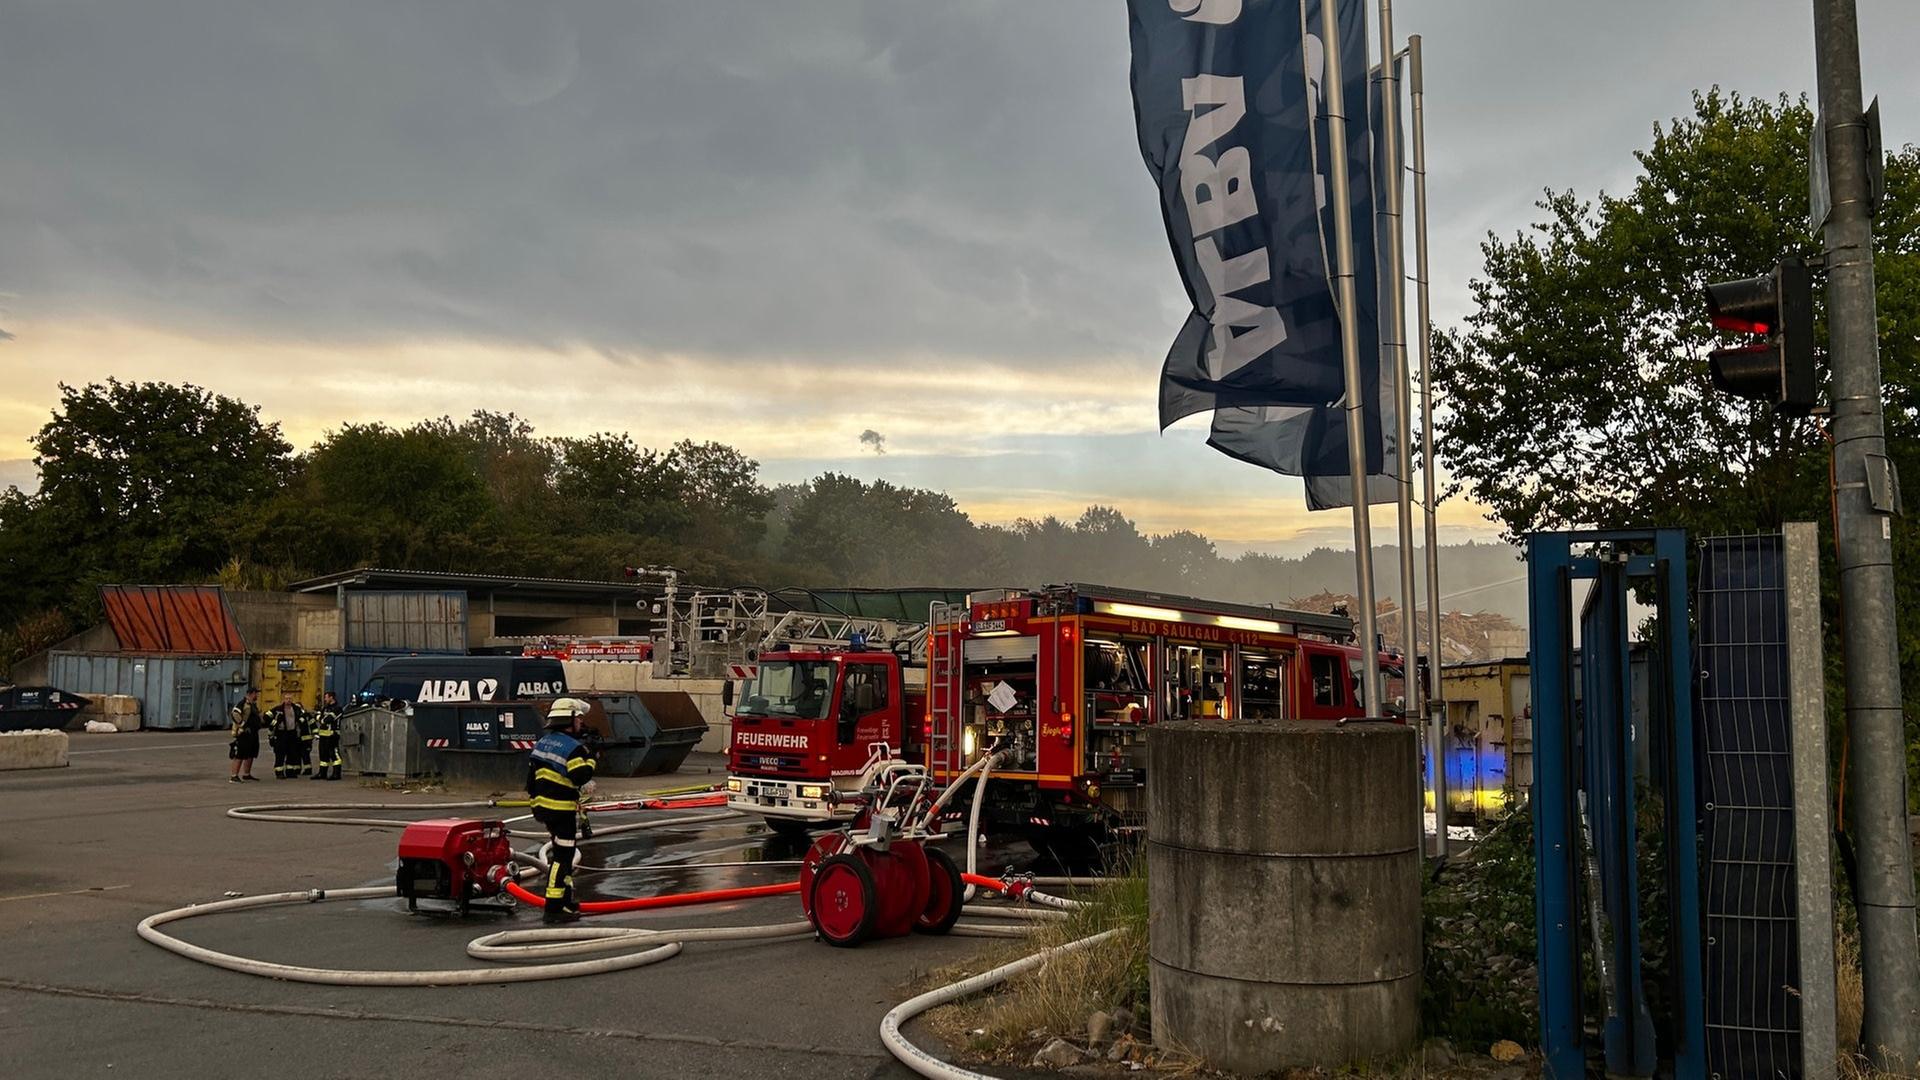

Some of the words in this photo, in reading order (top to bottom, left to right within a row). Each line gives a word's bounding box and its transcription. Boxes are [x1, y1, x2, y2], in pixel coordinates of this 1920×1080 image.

[1131, 621, 1157, 634] BAD
[1162, 624, 1220, 641] SAULGAU
[1239, 633, 1259, 645] 112
[417, 680, 472, 702] ALBA
[517, 682, 550, 695] ALBA
[736, 732, 808, 749] FEUERWEHR
[759, 757, 779, 766] IVECO
